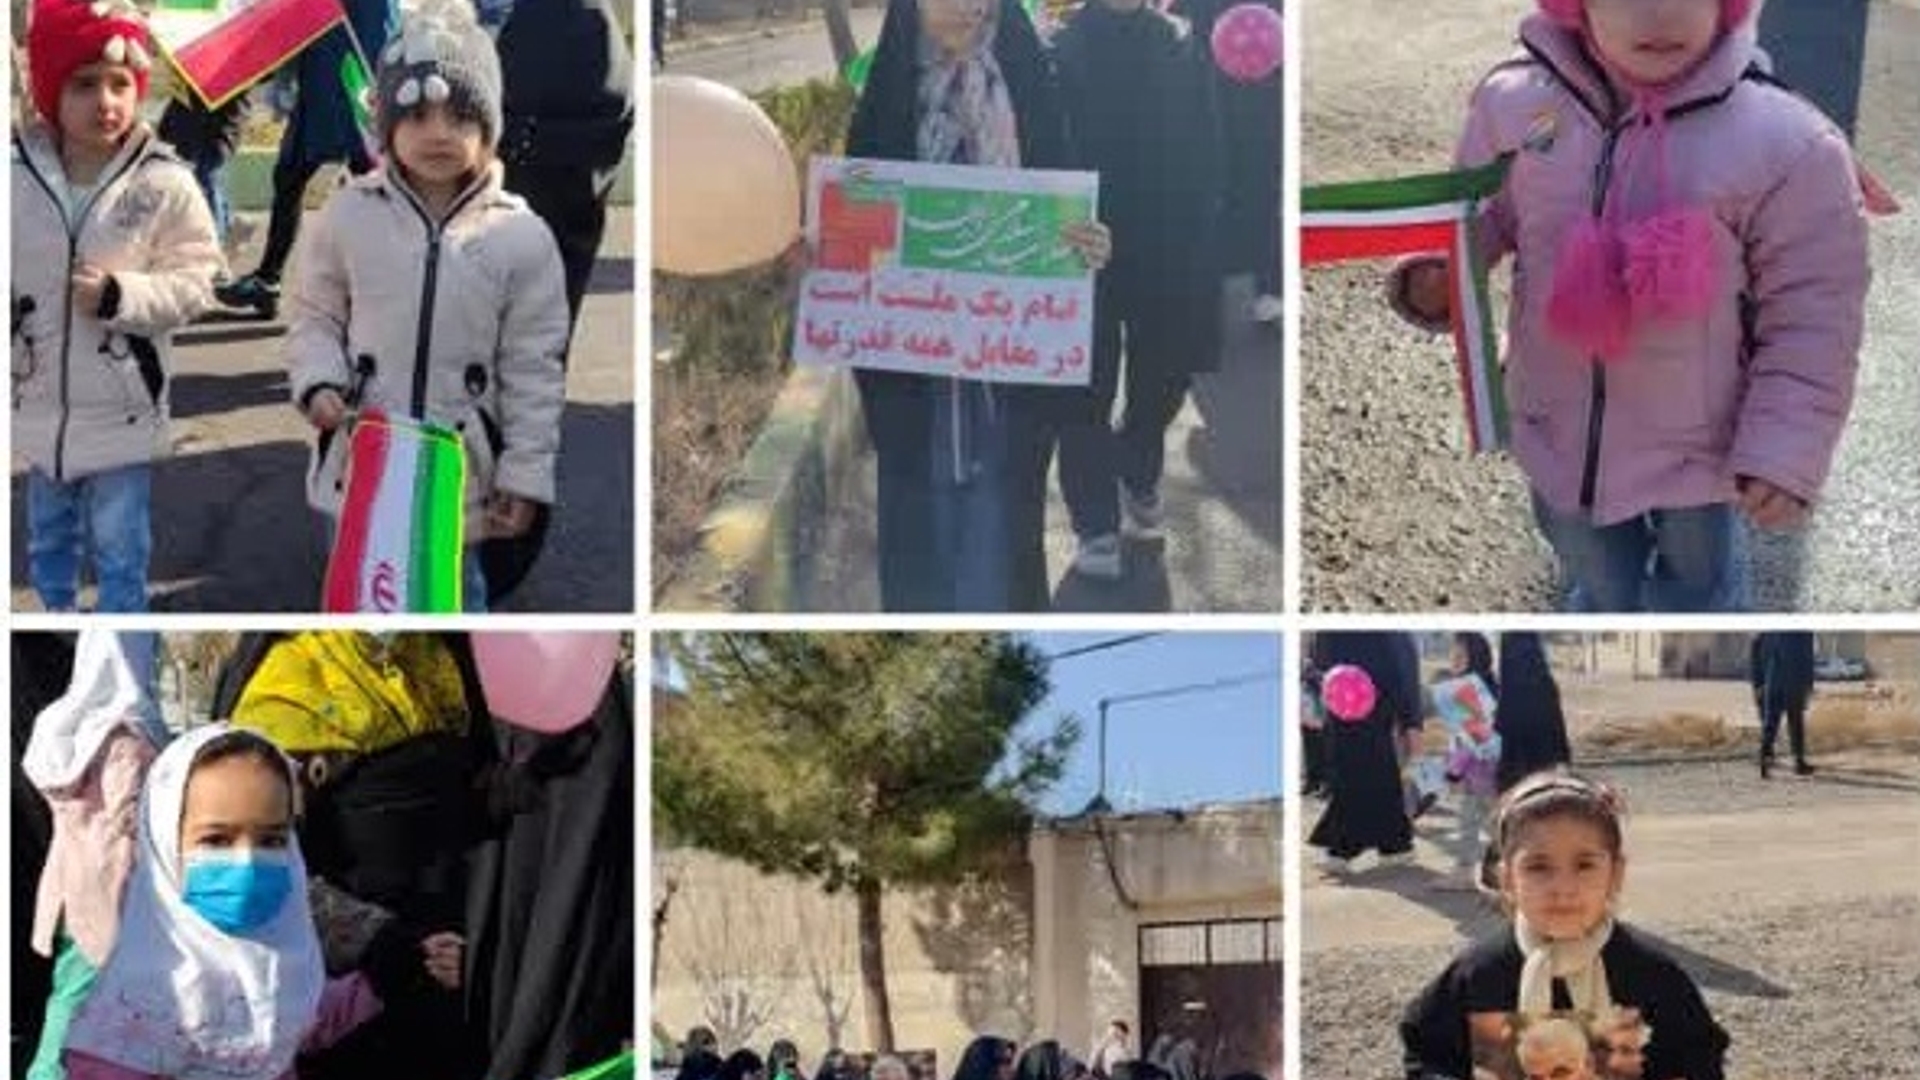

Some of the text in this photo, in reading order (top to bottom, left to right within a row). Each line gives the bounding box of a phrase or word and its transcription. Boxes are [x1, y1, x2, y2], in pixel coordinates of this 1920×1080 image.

[808, 278, 872, 303] است
[965, 291, 1014, 325] یک
[962, 333, 1038, 372] مقابل
[1046, 345, 1085, 378] در
